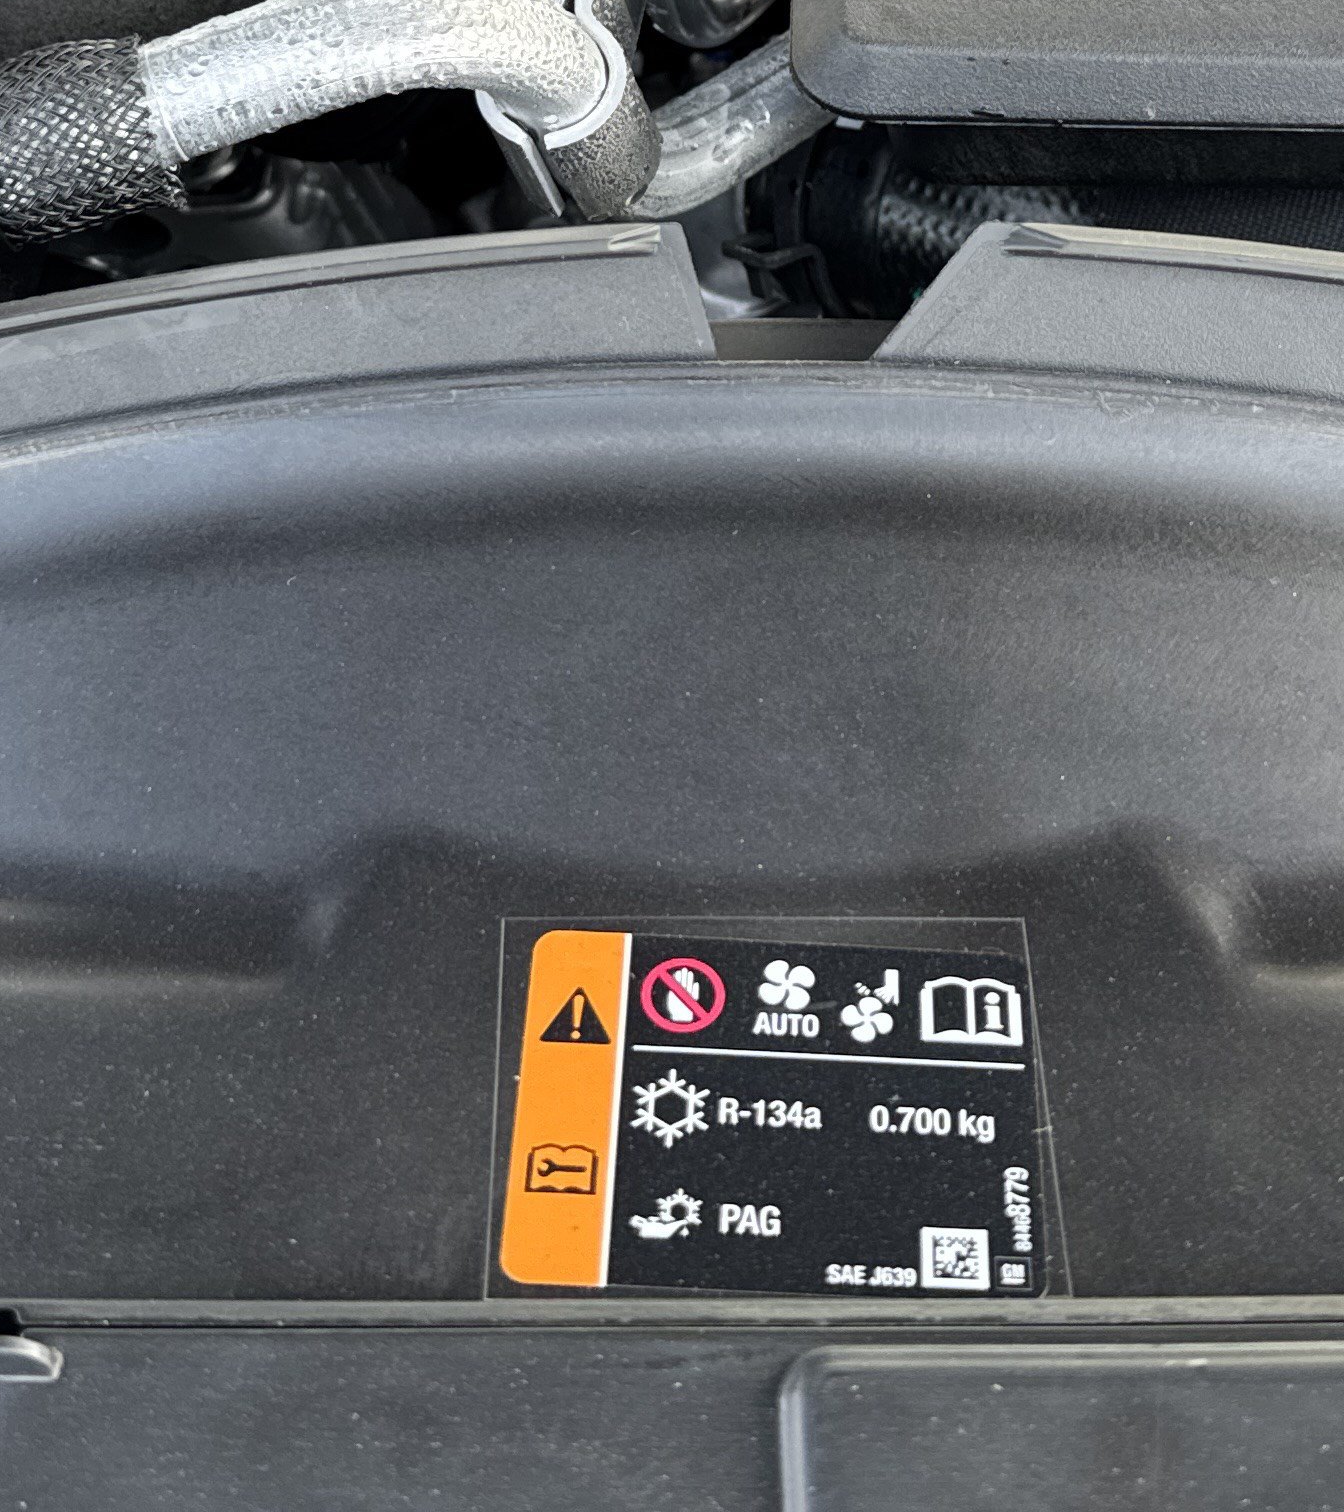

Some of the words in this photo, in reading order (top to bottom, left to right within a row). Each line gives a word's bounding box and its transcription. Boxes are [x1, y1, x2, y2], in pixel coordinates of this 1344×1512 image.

[752, 1011, 820, 1039] AUTO
[717, 1096, 823, 1131] R-134a
[868, 1103, 952, 1137] 0.700
[957, 1106, 997, 1144] kg
[718, 1202, 782, 1237] PAG
[824, 1263, 867, 1286] SAE
[867, 1265, 918, 1288] J639
[1000, 1262, 1026, 1280] GM
